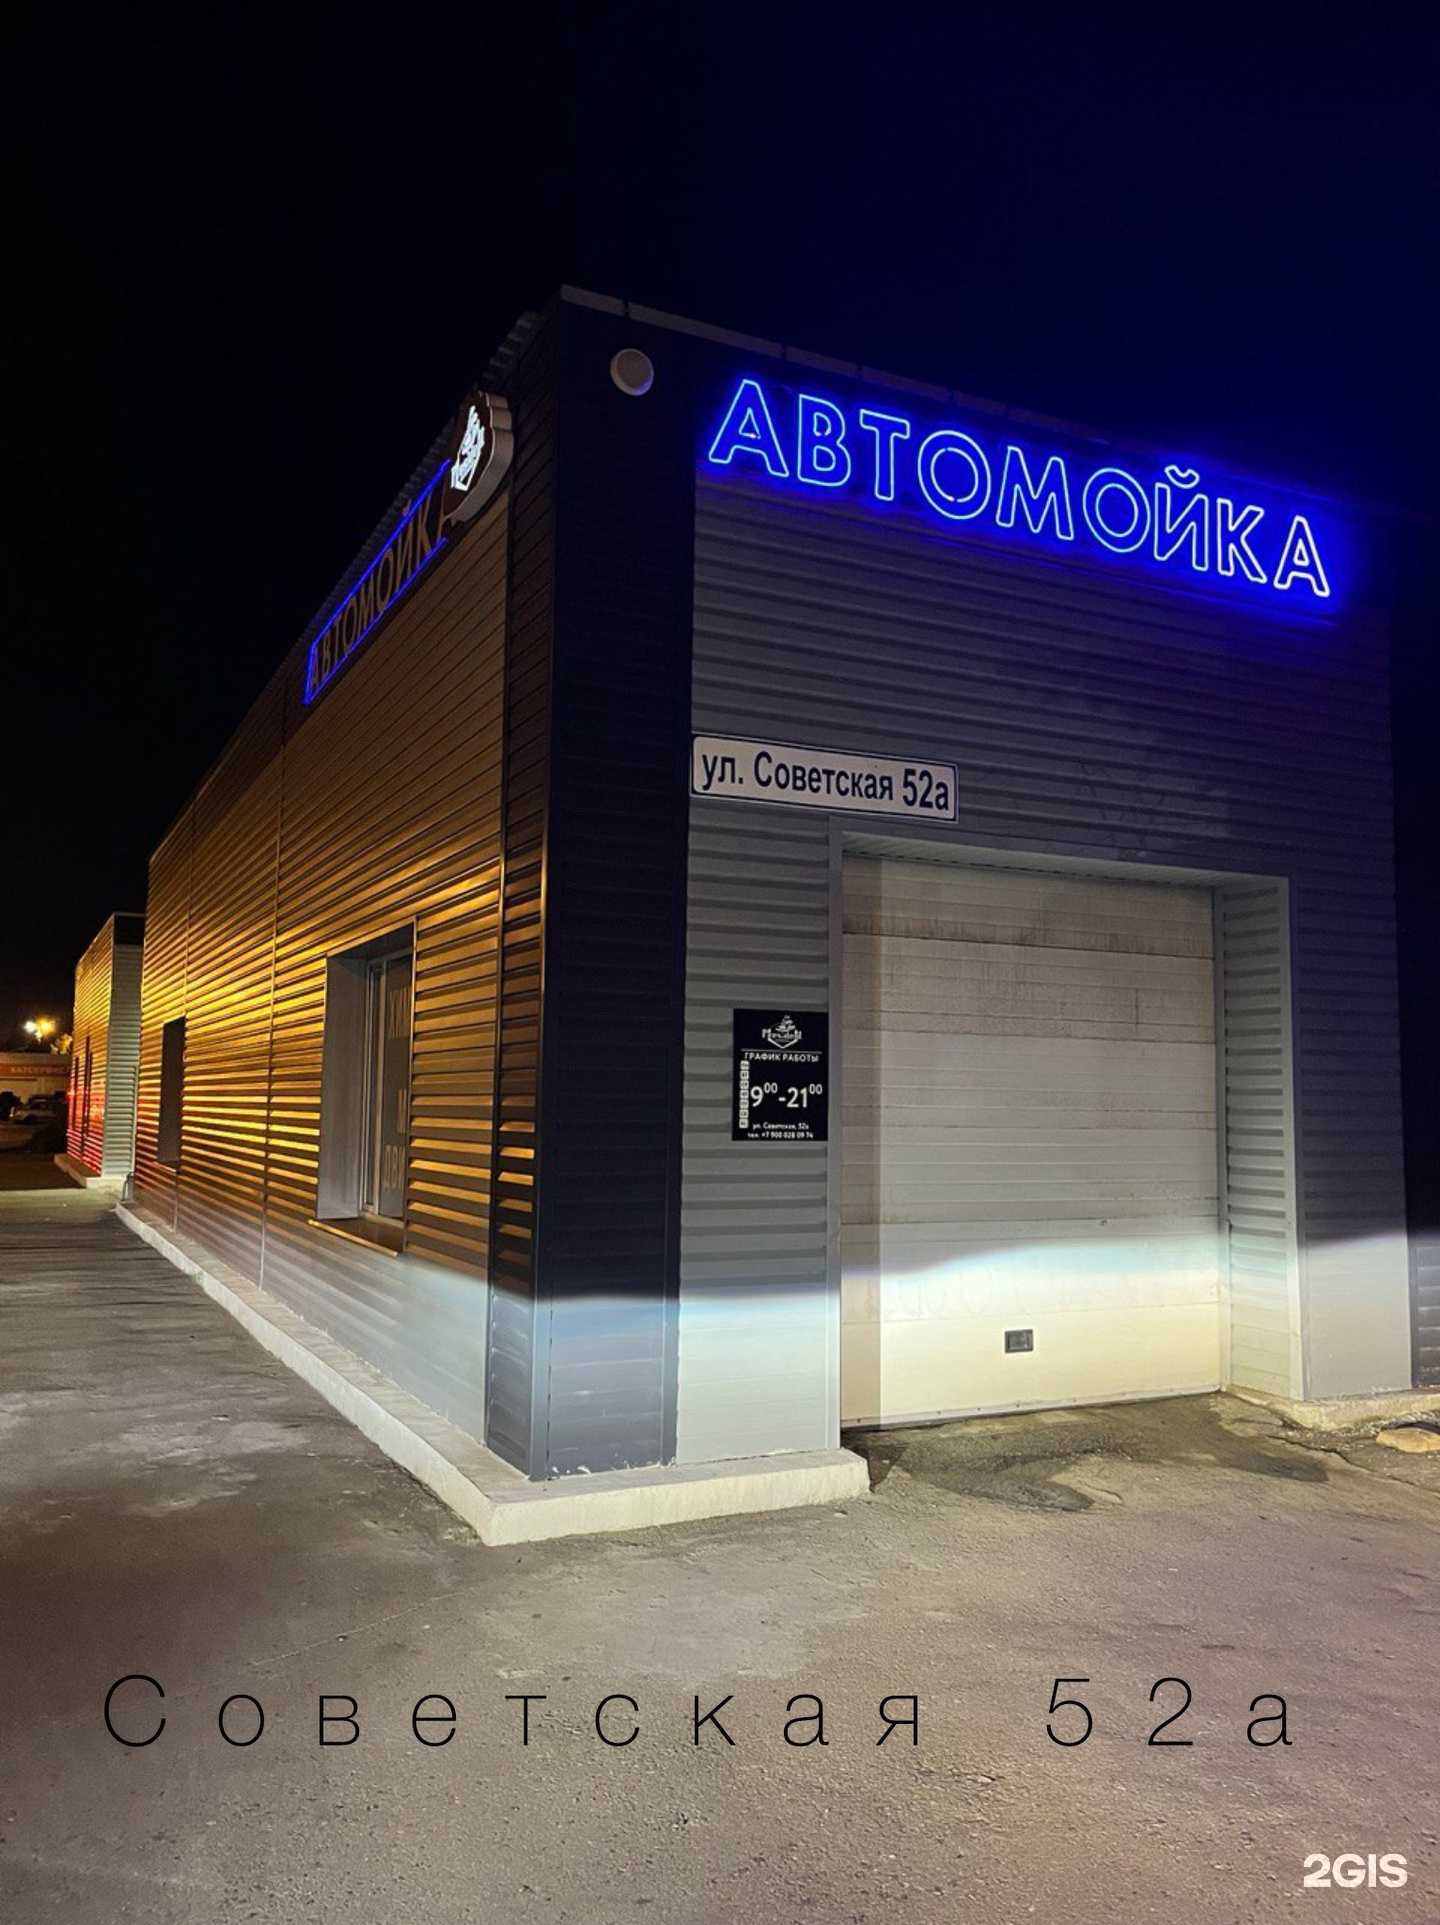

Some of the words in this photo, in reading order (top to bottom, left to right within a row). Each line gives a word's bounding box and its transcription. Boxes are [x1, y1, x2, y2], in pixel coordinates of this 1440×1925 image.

[709, 379, 1331, 597] АВТОМОЙКА
[702, 754, 744, 791] ул.
[754, 751, 893, 800] Советская
[903, 768, 949, 810] 52а
[744, 1052, 780, 1060] ГРАФИК
[782, 1053, 820, 1062] РАБОТЫ
